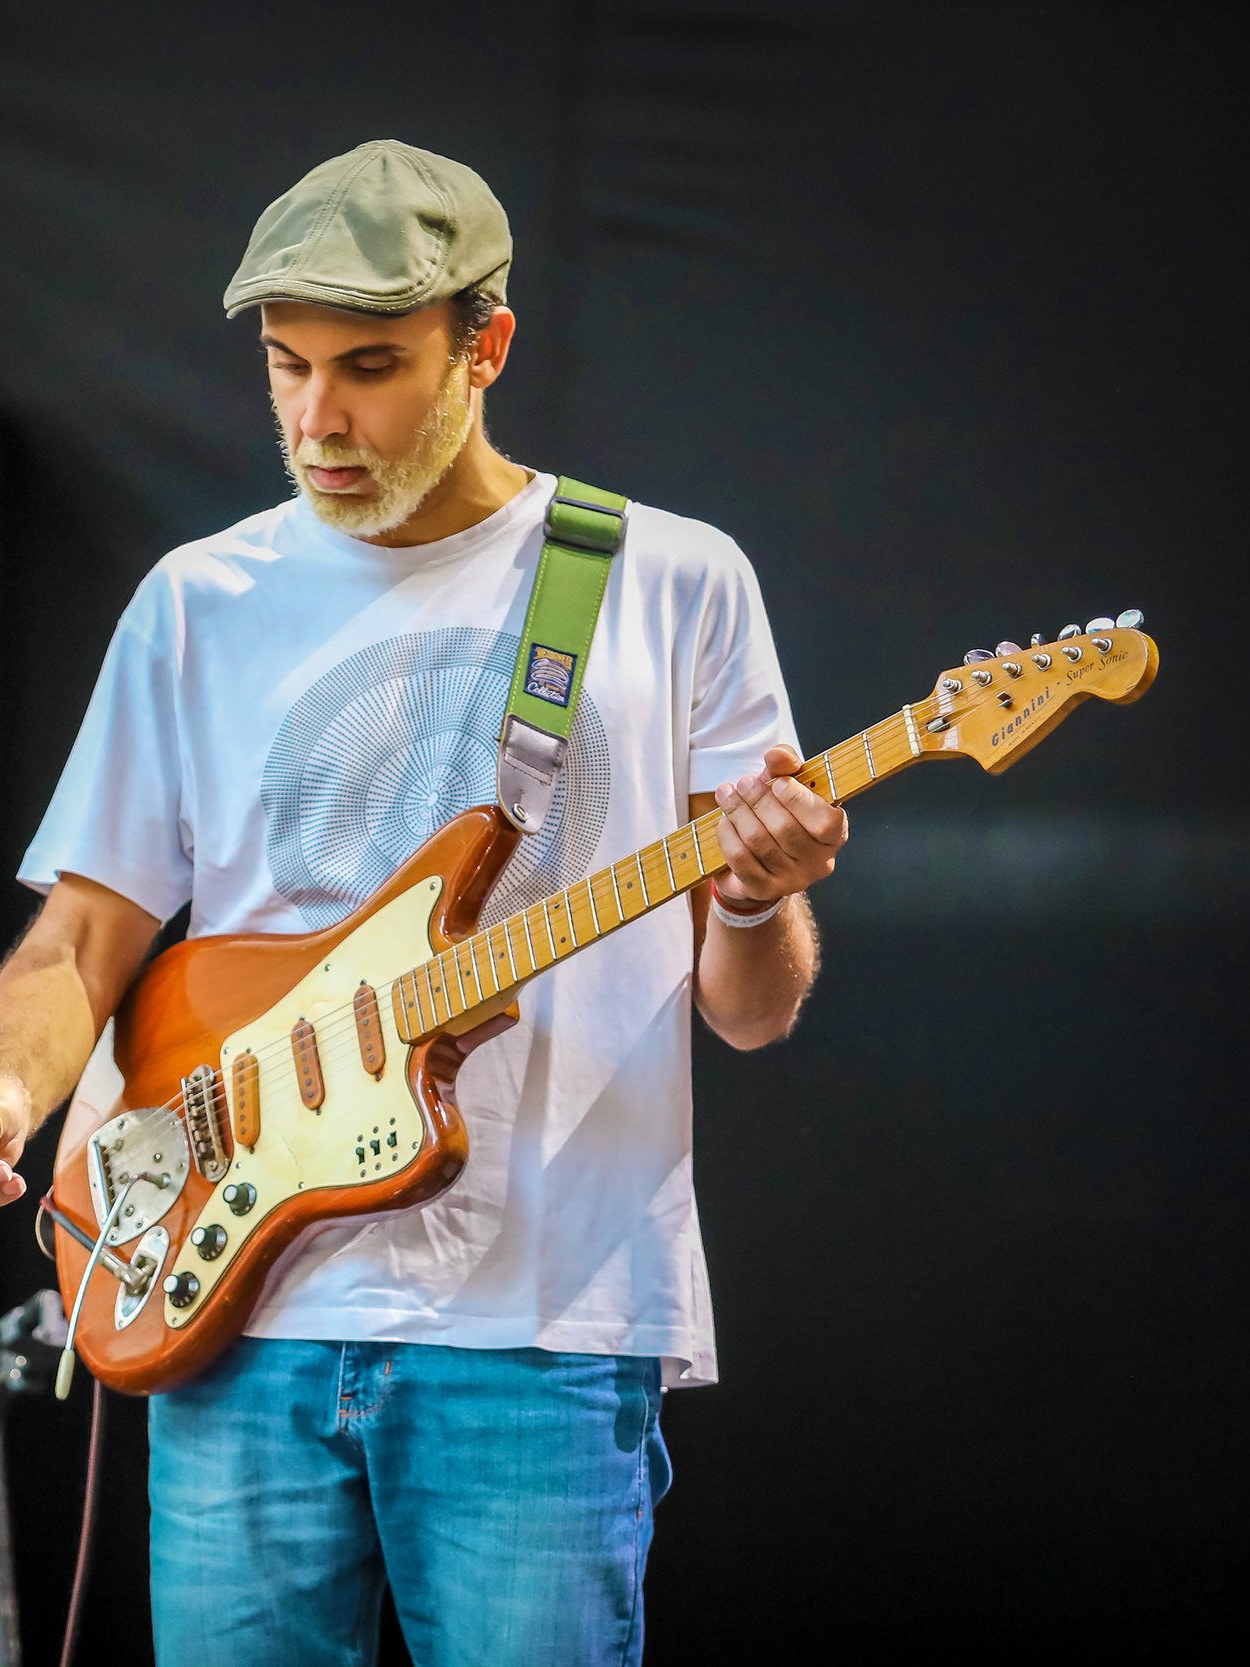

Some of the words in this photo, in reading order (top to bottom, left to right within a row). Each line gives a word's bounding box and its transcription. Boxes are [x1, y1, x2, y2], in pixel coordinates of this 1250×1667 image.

[991, 685, 1050, 747] Giannini
[1066, 661, 1095, 686] Super
[1098, 650, 1129, 671] Sonic
